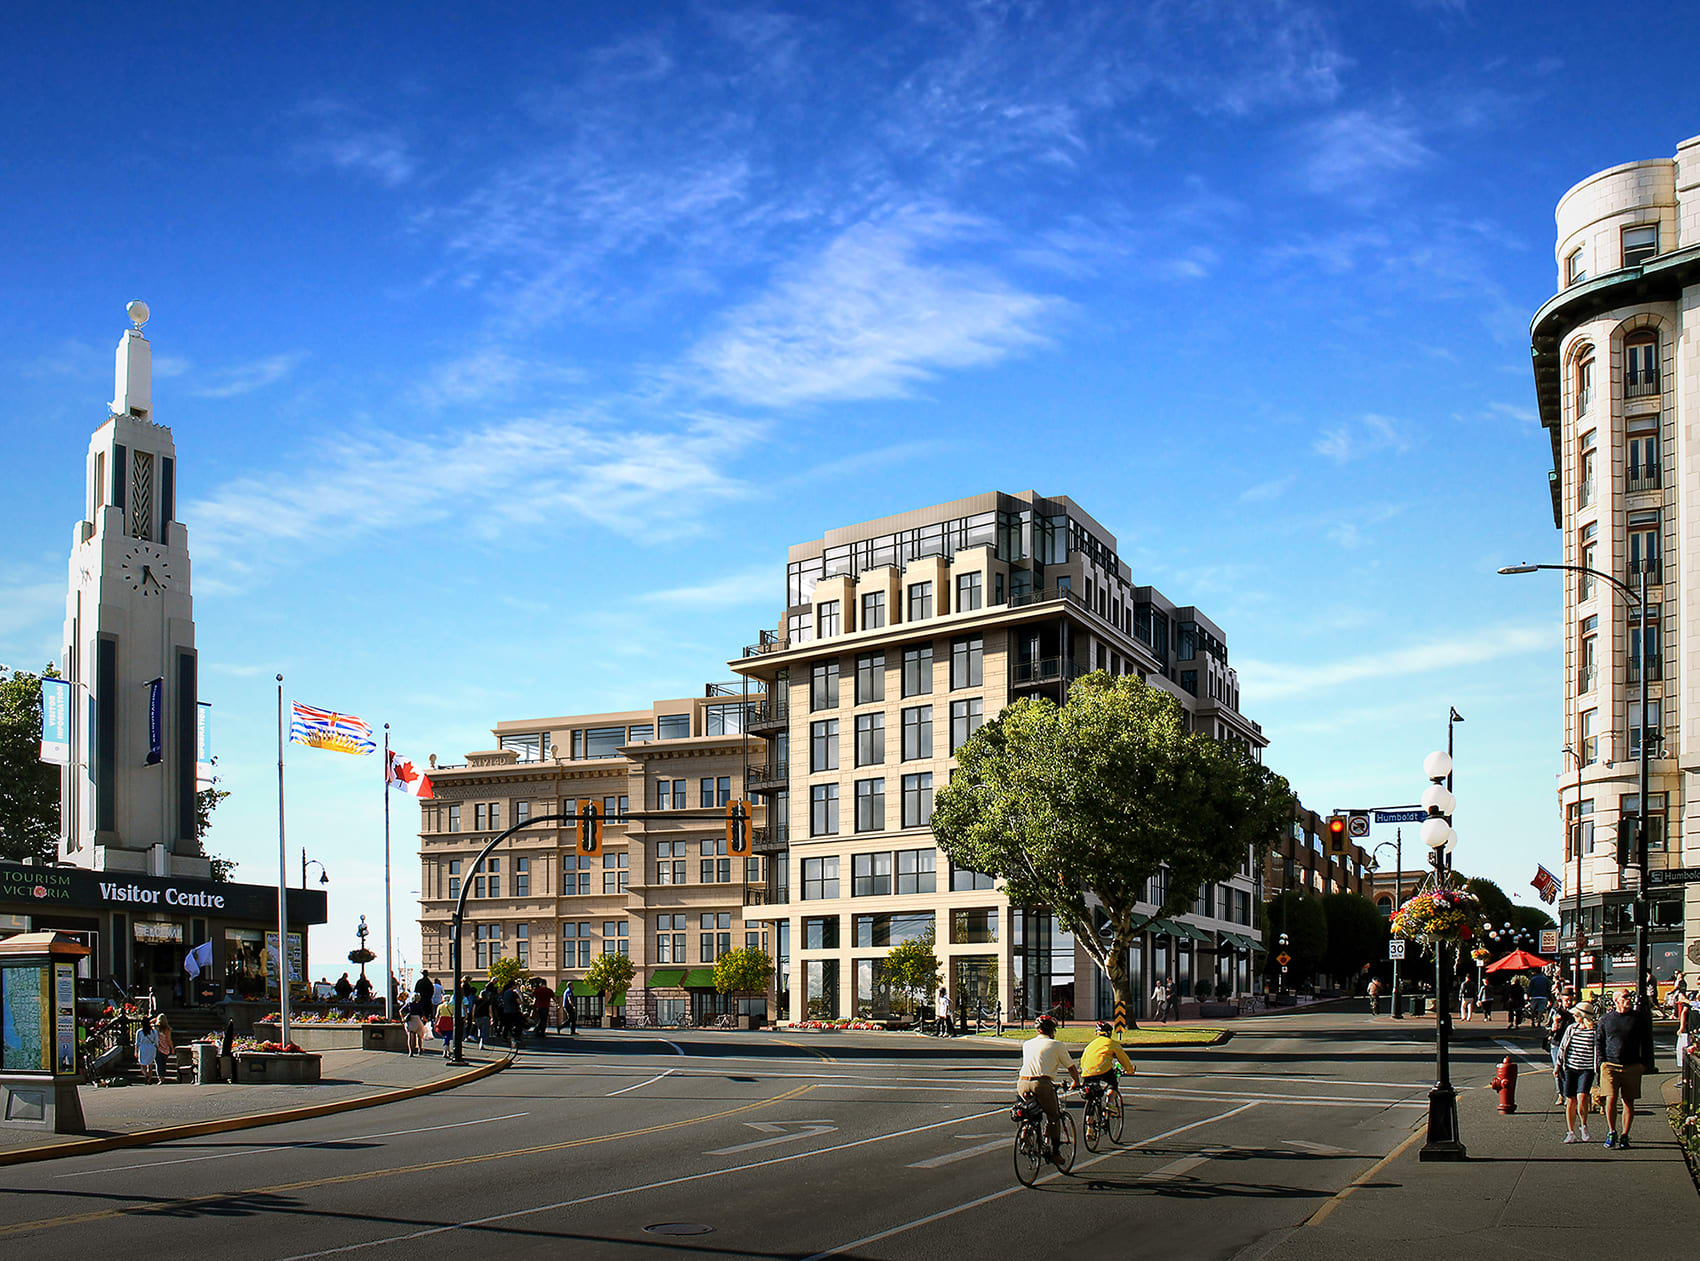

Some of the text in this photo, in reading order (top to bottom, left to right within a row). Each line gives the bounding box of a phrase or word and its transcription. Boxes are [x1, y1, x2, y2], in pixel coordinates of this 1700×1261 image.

[56, 685, 65, 739] INFORMATION
[1376, 812, 1418, 822] Humboldt
[3, 871, 71, 885] TOURISM
[99, 882, 225, 909] Visitor Centre
[1390, 944, 1404, 953] 30
